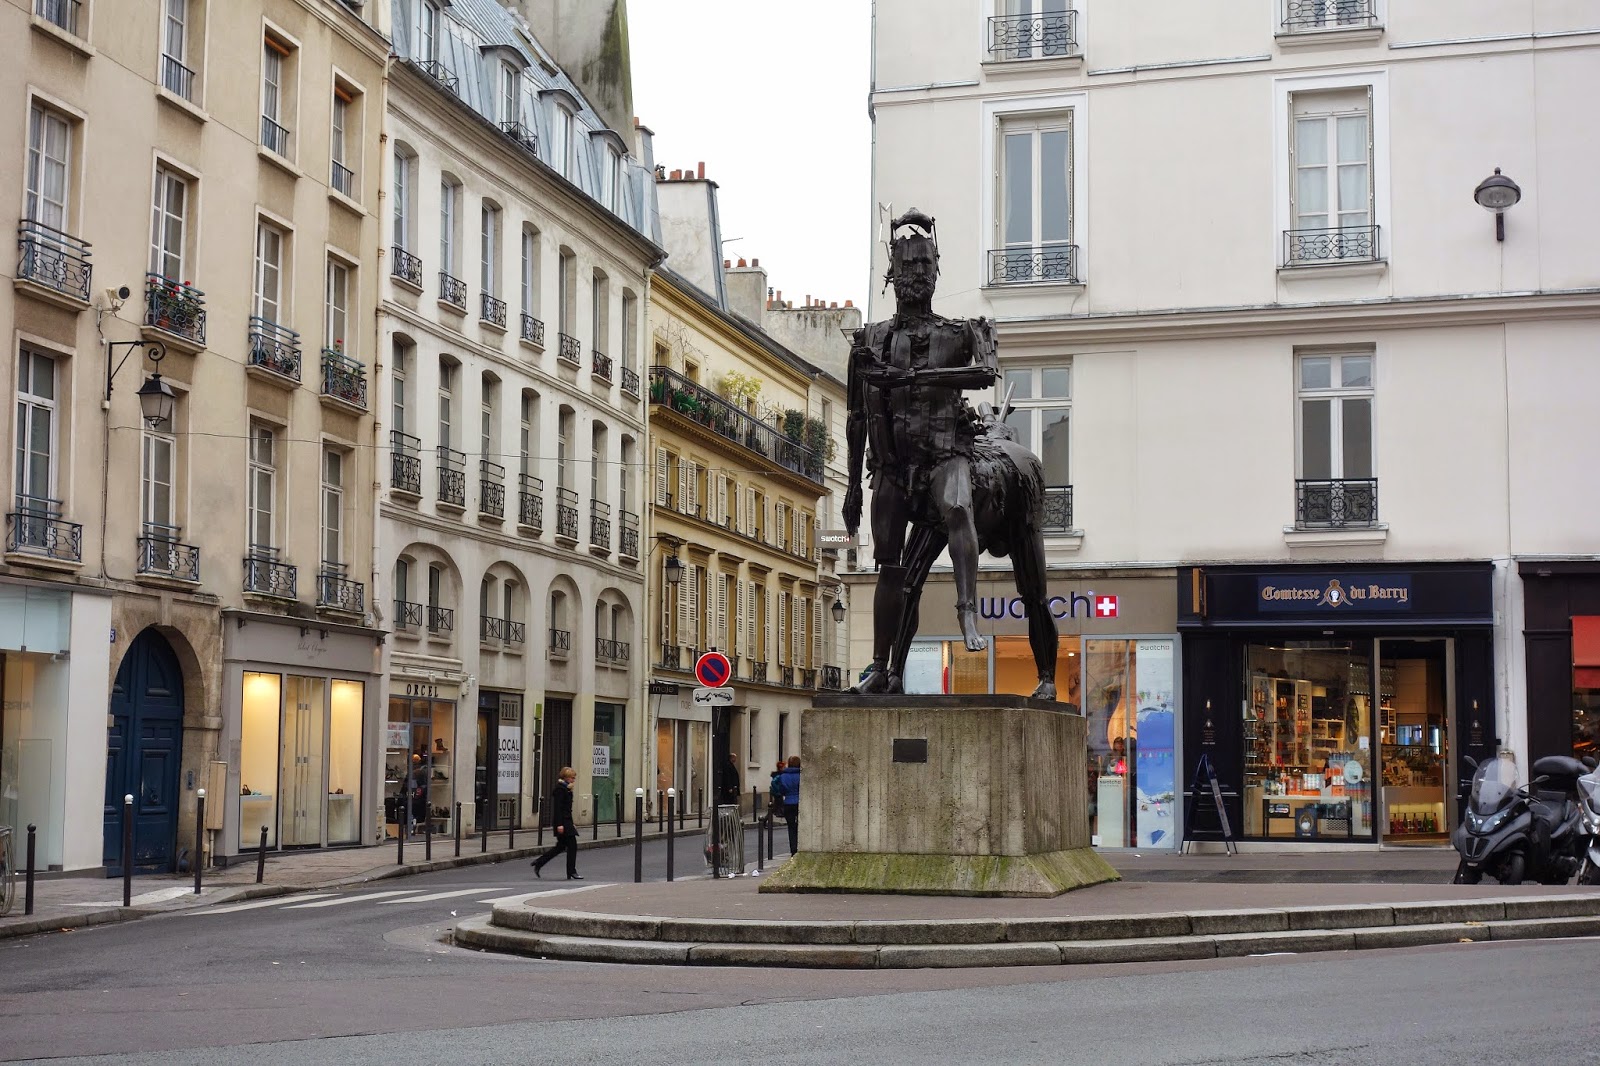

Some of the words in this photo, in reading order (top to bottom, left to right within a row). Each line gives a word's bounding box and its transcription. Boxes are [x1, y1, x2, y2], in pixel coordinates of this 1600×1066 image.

[1261, 585, 1320, 600] Comtesse
[1350, 585, 1366, 599] du
[1368, 584, 1409, 603] Barry
[406, 683, 439, 697] ORCEL
[498, 739, 519, 751] LOCAL
[498, 753, 520, 761] DISPONIBLE
